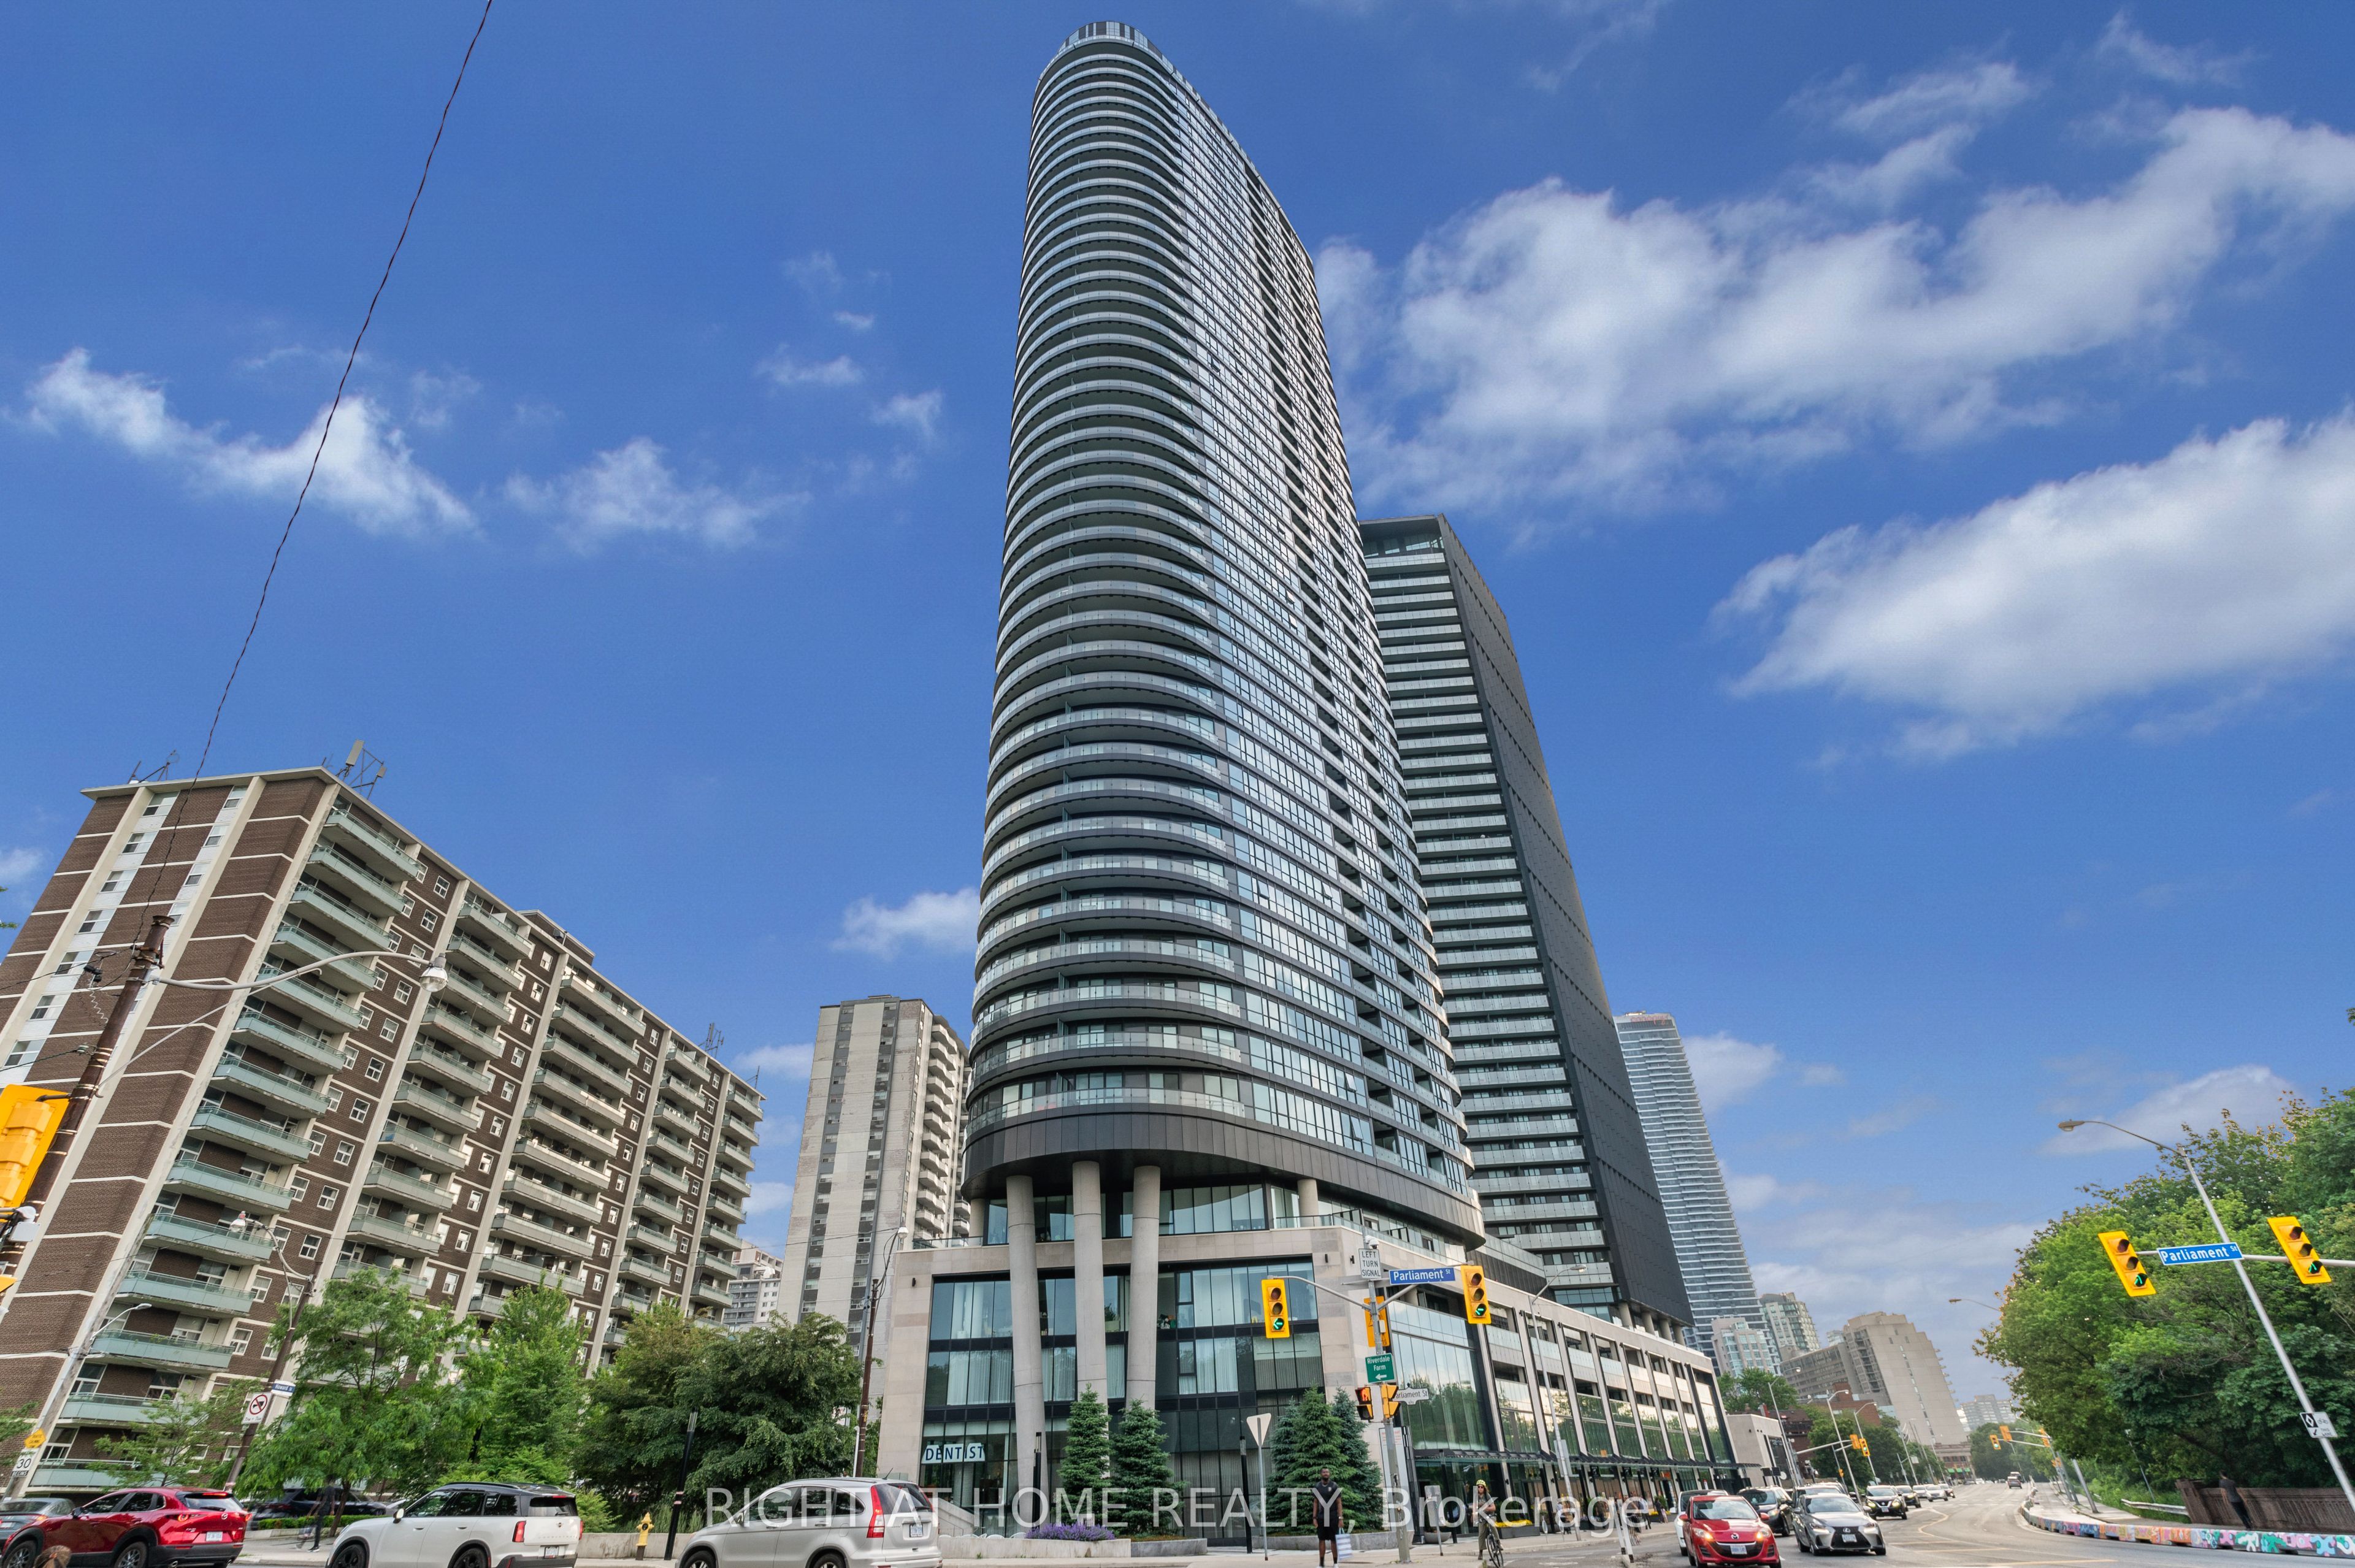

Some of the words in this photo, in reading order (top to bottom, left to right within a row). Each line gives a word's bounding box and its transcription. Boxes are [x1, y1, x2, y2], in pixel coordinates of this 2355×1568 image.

[2160, 1247, 2229, 1262] Parliament
[1393, 1269, 1444, 1281] Parliament
[925, 1446, 982, 1461] DENTIST
[17, 1458, 31, 1469] 30
